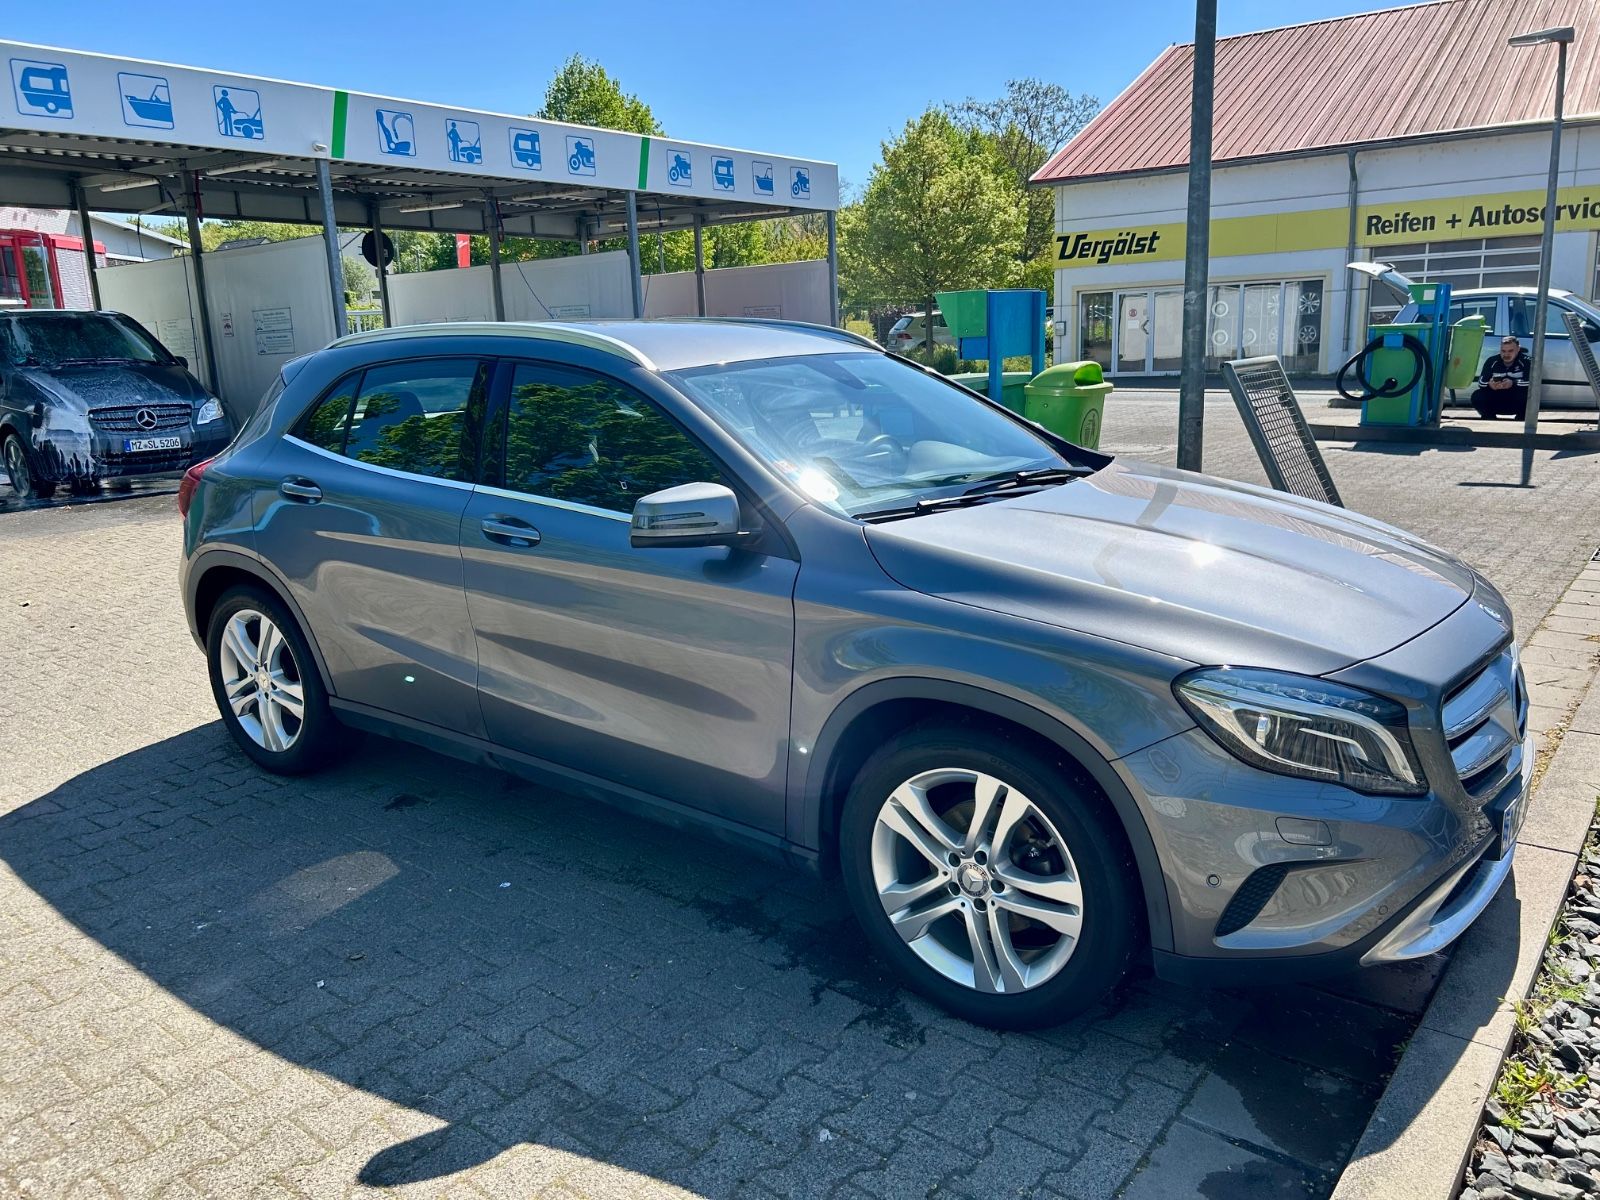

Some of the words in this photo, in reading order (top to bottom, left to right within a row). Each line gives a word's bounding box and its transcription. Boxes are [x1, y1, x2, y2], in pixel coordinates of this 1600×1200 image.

[1366, 211, 1436, 236] Reifen
[1446, 213, 1462, 229] +
[1056, 231, 1160, 264] Vergölst
[131, 441, 143, 450] MZ
[148, 440, 159, 449] SL
[160, 438, 180, 448] 5206
